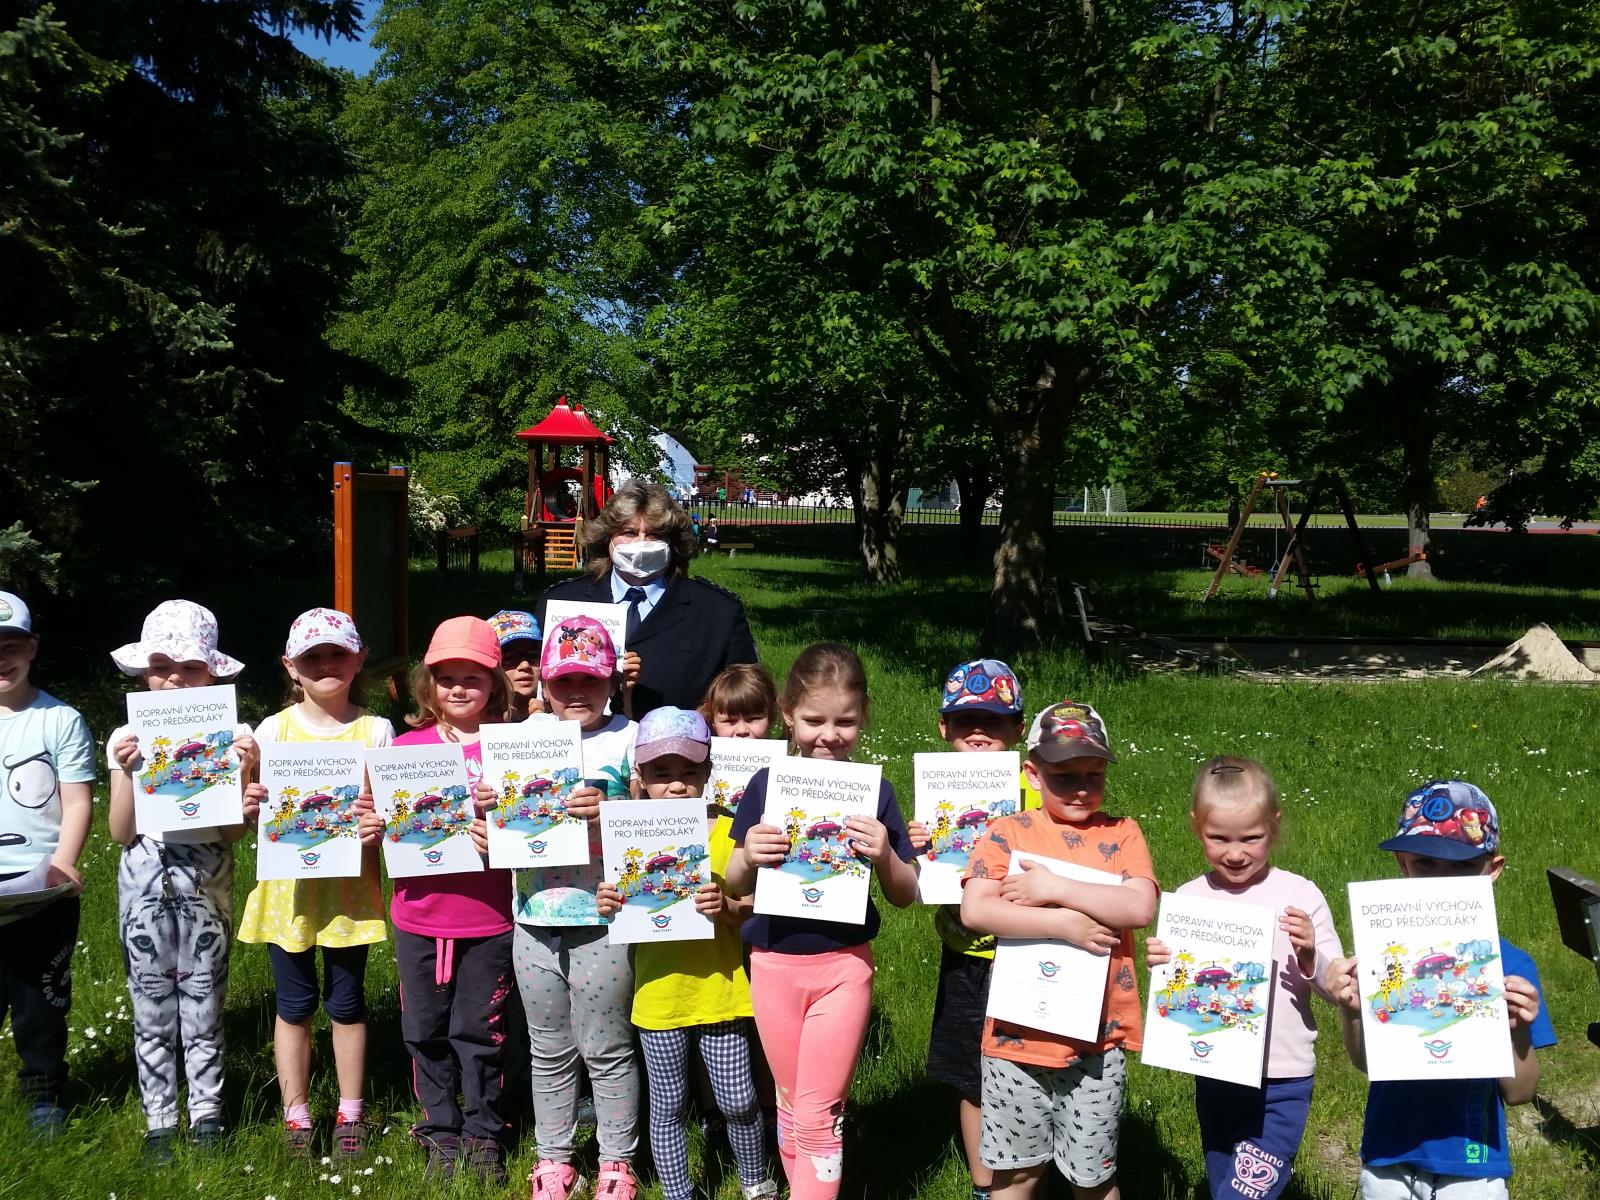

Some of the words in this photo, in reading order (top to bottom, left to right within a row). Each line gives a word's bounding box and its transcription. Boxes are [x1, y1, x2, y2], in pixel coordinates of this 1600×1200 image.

[600, 618, 620, 626] HOVA
[136, 705, 183, 718] DOPRAVNÍ
[185, 703, 228, 714] VÝCHOVA
[142, 719, 160, 728] PRO
[163, 713, 224, 726] PŘEDŠKOLÁKY
[487, 739, 530, 751] DOPRAVNÍ
[532, 738, 574, 748] VÝCHOVA
[493, 752, 510, 761] PRO
[511, 749, 569, 760] PŘEDŠKOLÁKY
[710, 753, 741, 761] OPRAVNÍ
[743, 754, 771, 764] VÝCHO
[268, 757, 314, 768] DOPRAVNÍ
[316, 757, 357, 766] VÝCHOVA
[374, 761, 417, 773] DOPRAVNÍ
[418, 759, 459, 769] VÝCHOVA
[711, 763, 722, 771] RO
[273, 769, 291, 777] PRO
[293, 767, 352, 777] PŘEDŠKOLÁKY
[381, 773, 398, 782] PRO
[400, 769, 455, 780] PŘEDŠKOLÁKY
[922, 769, 967, 779] DOPRAVNÍ
[969, 768, 1012, 778] VÝCHOVA
[776, 775, 825, 787] DOPRAVNÍ
[827, 778, 871, 792] VÝCHOVA
[927, 782, 945, 790] PRO
[947, 780, 1007, 790] PŘEDŠKOLÁKY
[780, 787, 799, 797] PRO
[802, 788, 865, 803] PŘEDŠKOLÁKY
[608, 817, 654, 828] DOPRAVNÍ
[656, 816, 700, 826] VÝCHOVA
[614, 830, 632, 838] PRO
[634, 827, 695, 838] PŘEDŠKOLÁKY
[1361, 899, 1422, 915] DOPRAVNÍ
[1425, 898, 1484, 912] VÝCHOVA
[1166, 913, 1215, 929] DOPRAVNÍ
[1216, 920, 1264, 937] VÝCHOVA
[1369, 918, 1393, 928] PRO
[1397, 914, 1477, 928] PŘEDŠKOLÁKY
[1170, 927, 1188, 938] PRO
[1190, 929, 1257, 949] PŘEDŠKOLÁKY
[1240, 1141, 1284, 1168] TECHNO
[1238, 1155, 1274, 1190] 82
